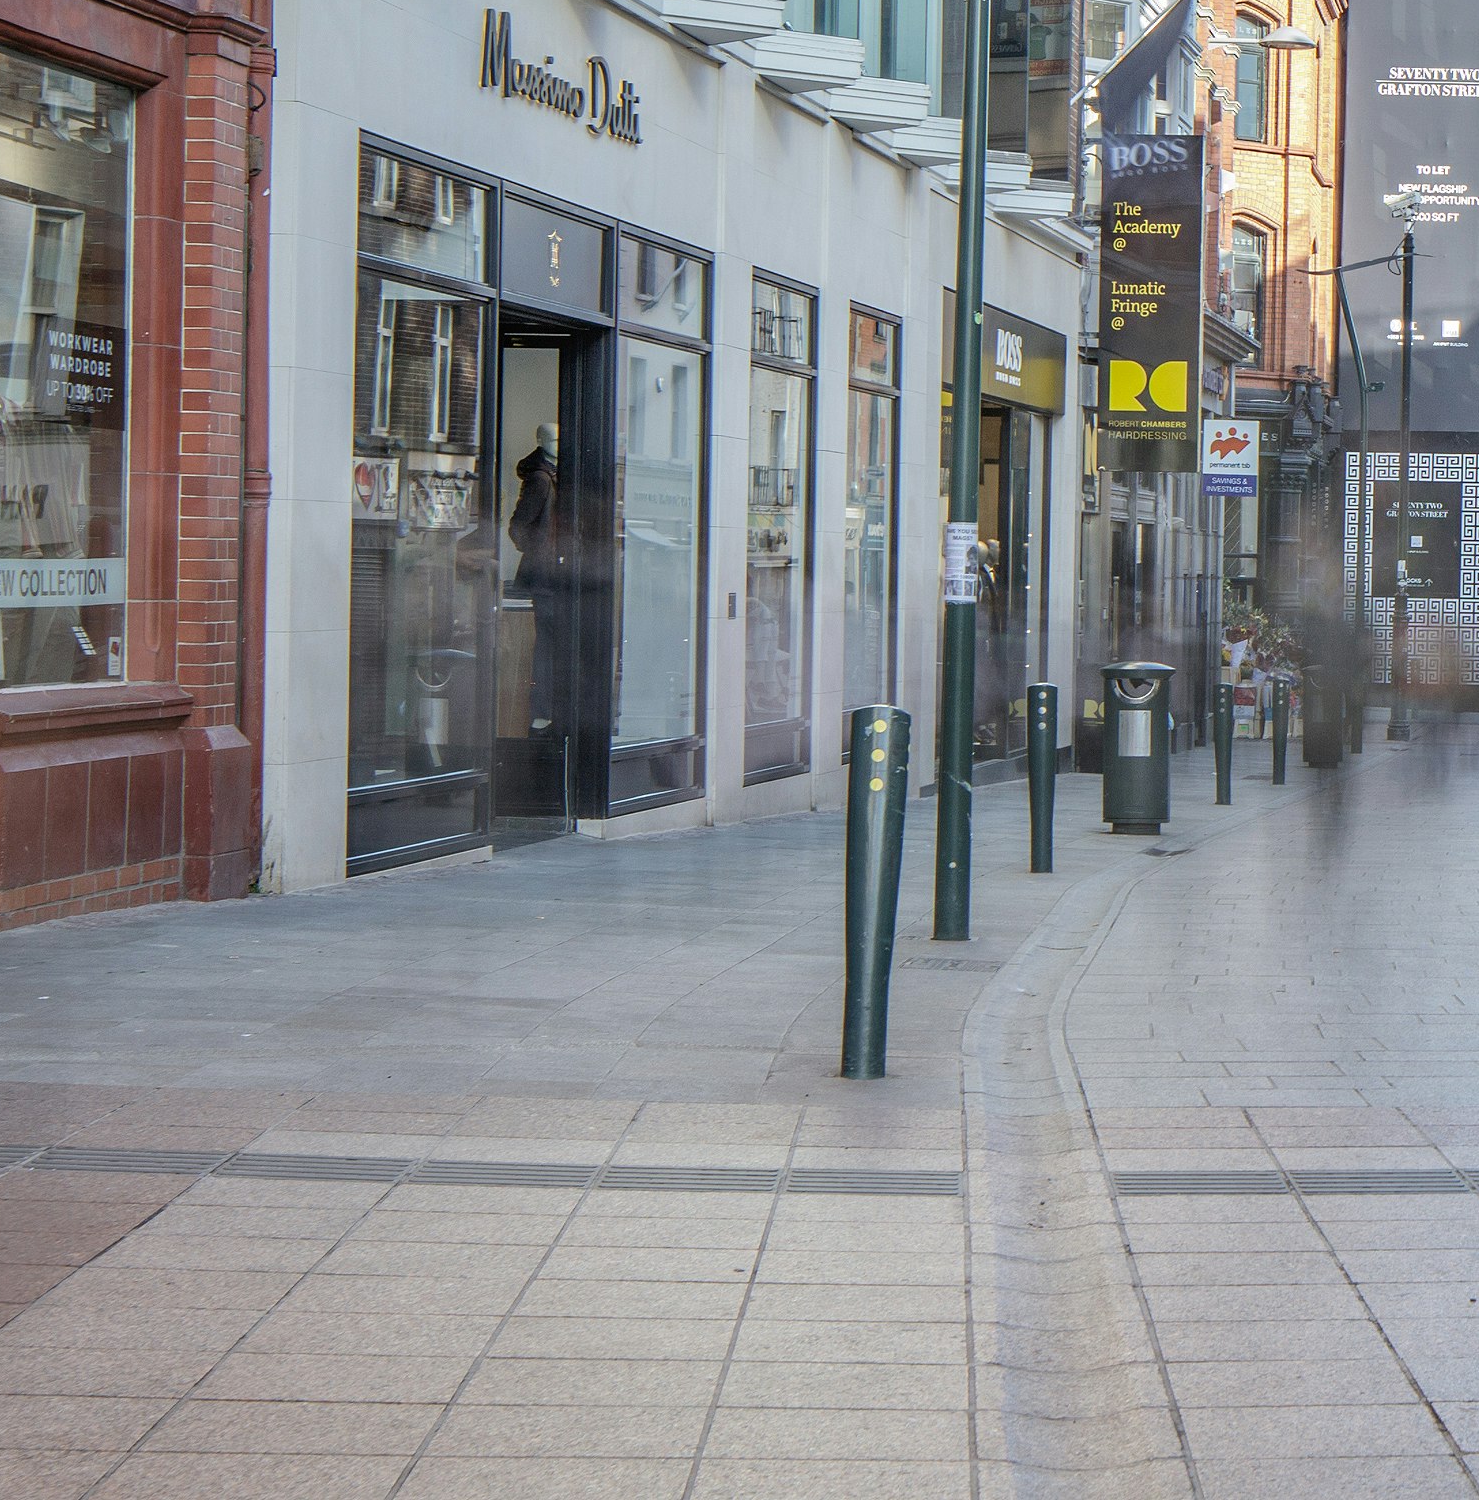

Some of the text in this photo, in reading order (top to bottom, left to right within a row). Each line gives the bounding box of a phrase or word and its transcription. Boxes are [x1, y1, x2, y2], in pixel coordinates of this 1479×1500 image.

[478, 8, 643, 145] Massimo Dutti
[1389, 67, 1449, 81] SEVENTY
[1378, 83, 1442, 96] GRAFTON
[1110, 139, 1189, 171] BOSS
[1416, 165, 1450, 175] TO LET
[1398, 183, 1467, 194] NEW FLAGSHIP
[1113, 202, 1141, 217] The
[1442, 212, 1469, 222] SQ FT
[1112, 219, 1182, 239] Academy
[1113, 238, 1127, 253] @
[1111, 280, 1166, 296] Lunatic
[1111, 298, 1158, 317] Fringe
[1111, 317, 1125, 331] @
[48, 330, 114, 356] WORKWEAR
[996, 328, 1023, 373] BOSS
[50, 353, 112, 378] WARDROBE
[46, 380, 114, 404] UP TO 30% OFF
[1109, 420, 1139, 428] ROBERT
[1109, 431, 1187, 441] HAIRDRESSING
[1212, 477, 1247, 485] SAVINGS &
[1205, 485, 1253, 494] INVESTMENTS
[1426, 501, 1443, 510] TWO
[1420, 511, 1449, 519] STREET
[19, 568, 107, 597] COLLECTION
